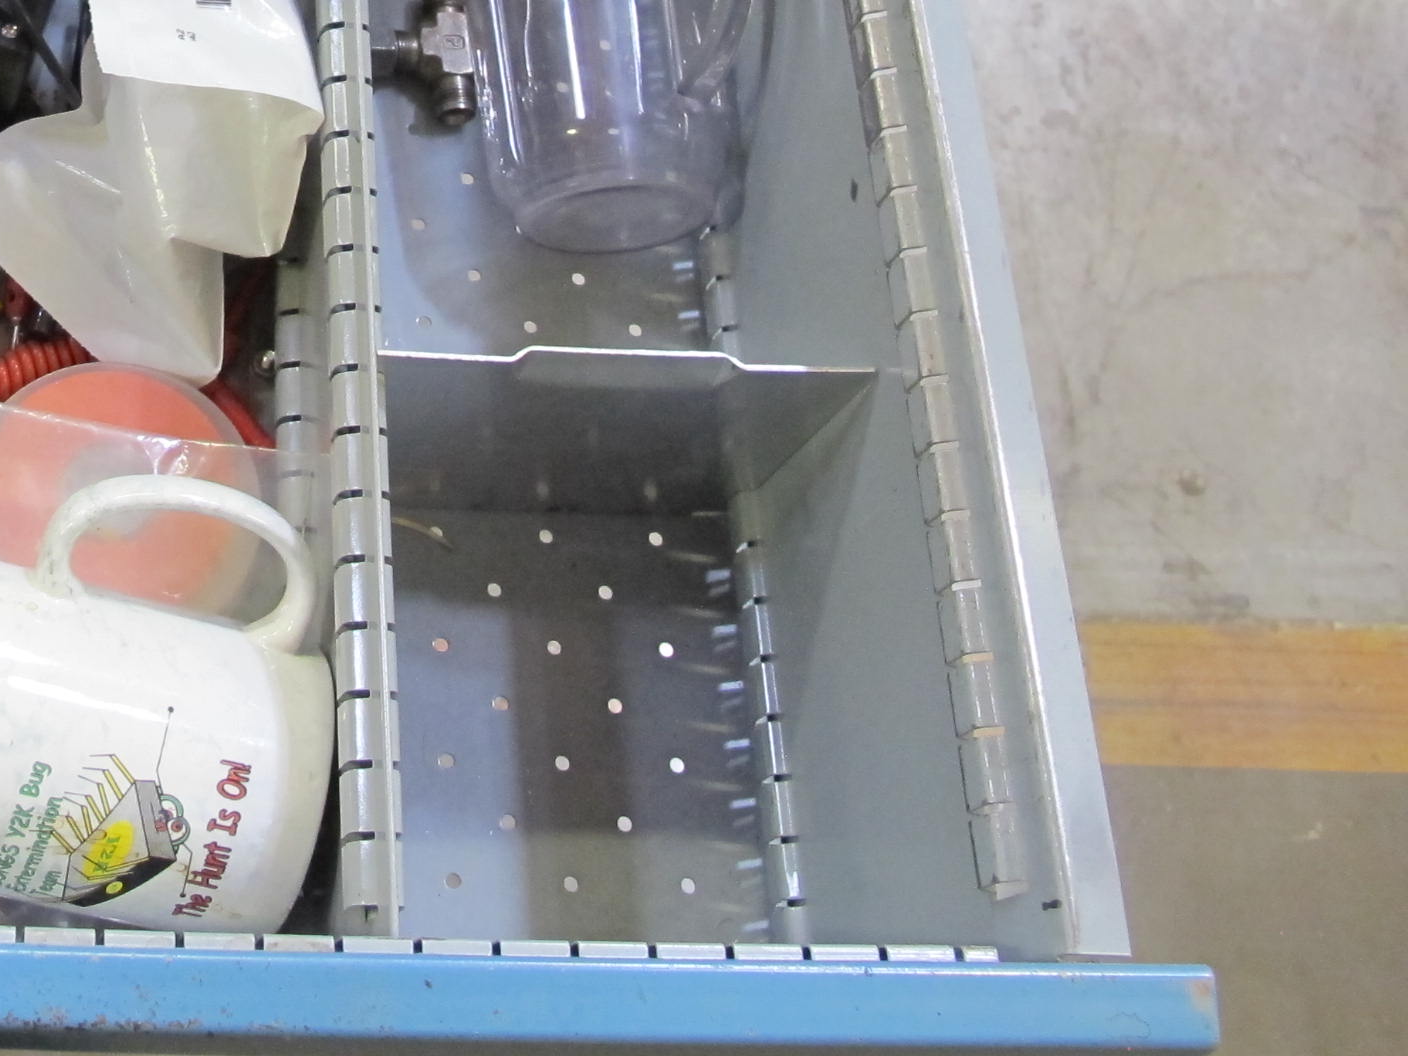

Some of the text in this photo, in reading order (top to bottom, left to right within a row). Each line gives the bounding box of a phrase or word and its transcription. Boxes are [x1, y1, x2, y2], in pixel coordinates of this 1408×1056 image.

[18, 760, 53, 798] Bug
[5, 803, 35, 838] Y2K
[6, 796, 64, 893] Extermination
[171, 759, 252, 918] The Hunt Is On!
